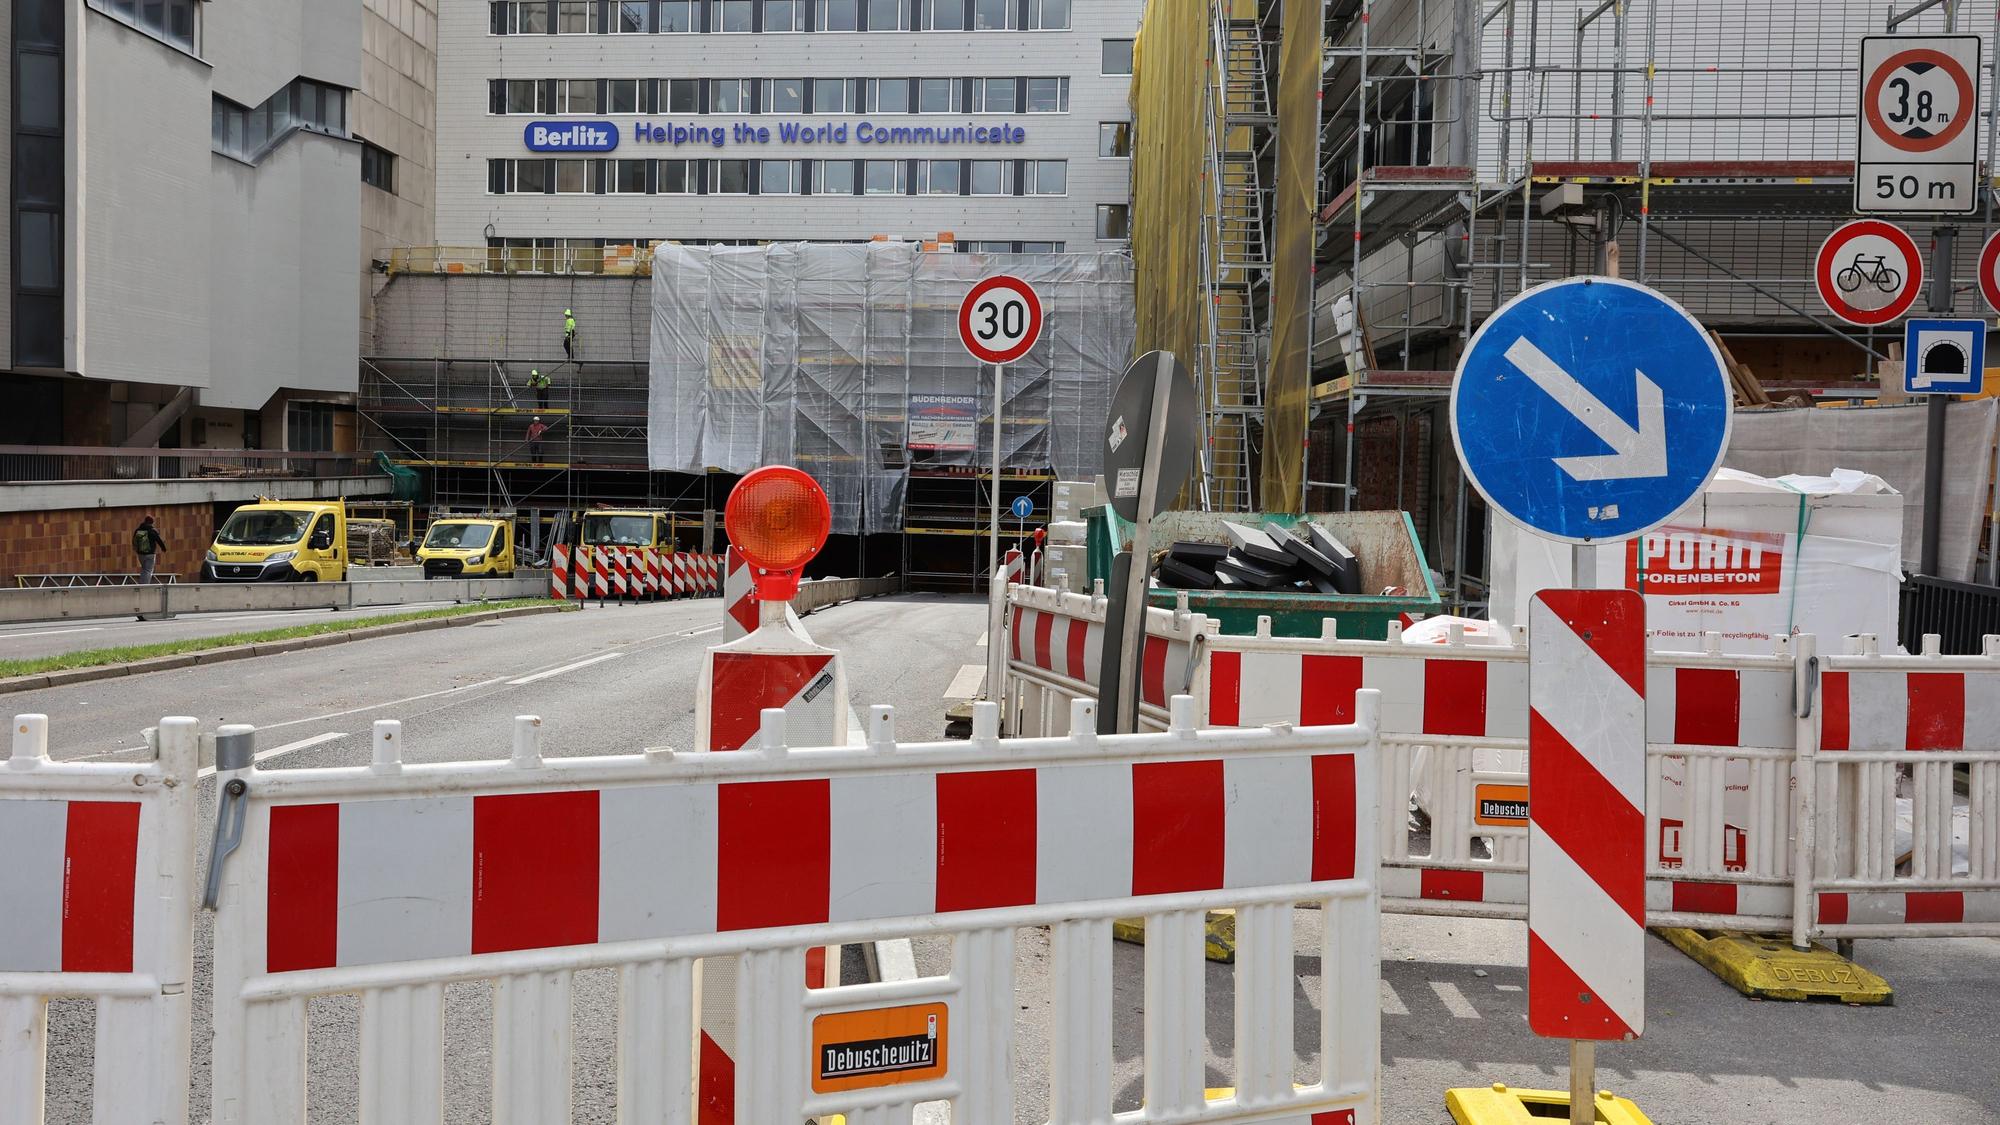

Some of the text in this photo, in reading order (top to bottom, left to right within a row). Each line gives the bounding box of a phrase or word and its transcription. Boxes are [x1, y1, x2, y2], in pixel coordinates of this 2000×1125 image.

[1888, 77, 1950, 125] 3,8 m
[533, 125, 608, 146] Berlitz
[634, 121, 1026, 147] Helping the World Communicate
[1876, 175, 1955, 199] 50 m
[977, 300, 1024, 340] 30
[1636, 572, 1761, 583] PORENBETON
[1656, 629, 1676, 637] Folie
[1773, 965, 1858, 984] DEBUZ
[827, 1039, 929, 1072] Debuschewitz
